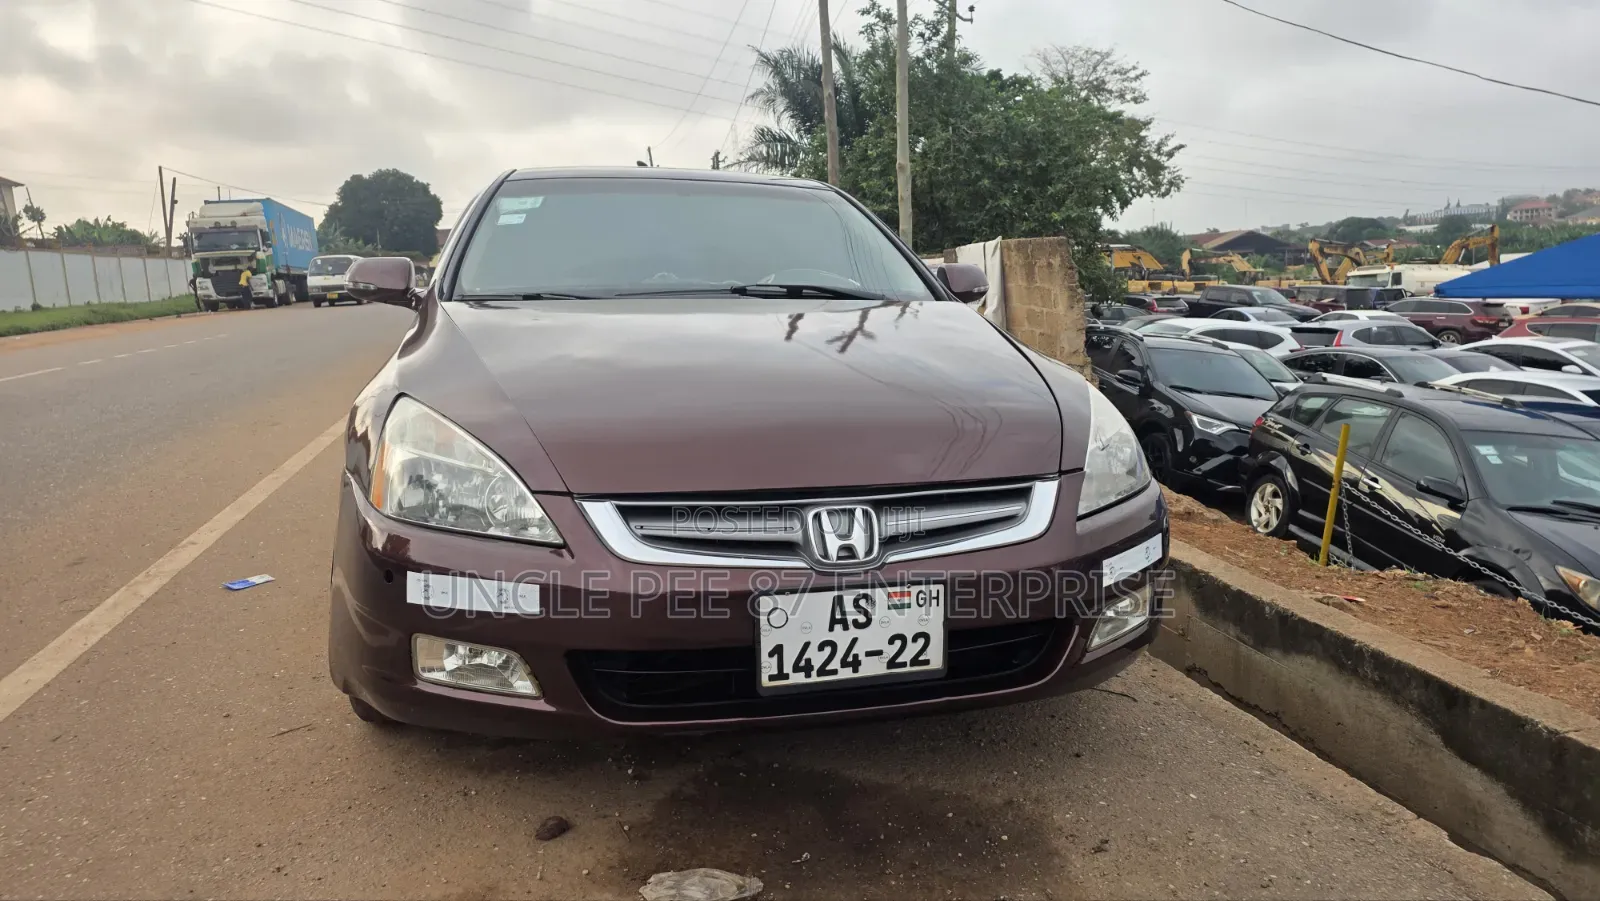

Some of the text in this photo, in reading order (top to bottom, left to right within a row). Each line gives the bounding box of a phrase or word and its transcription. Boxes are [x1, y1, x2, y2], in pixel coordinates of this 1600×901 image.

[828, 593, 874, 632] AS
[915, 589, 940, 608] GH
[767, 631, 931, 682] 1424-22
